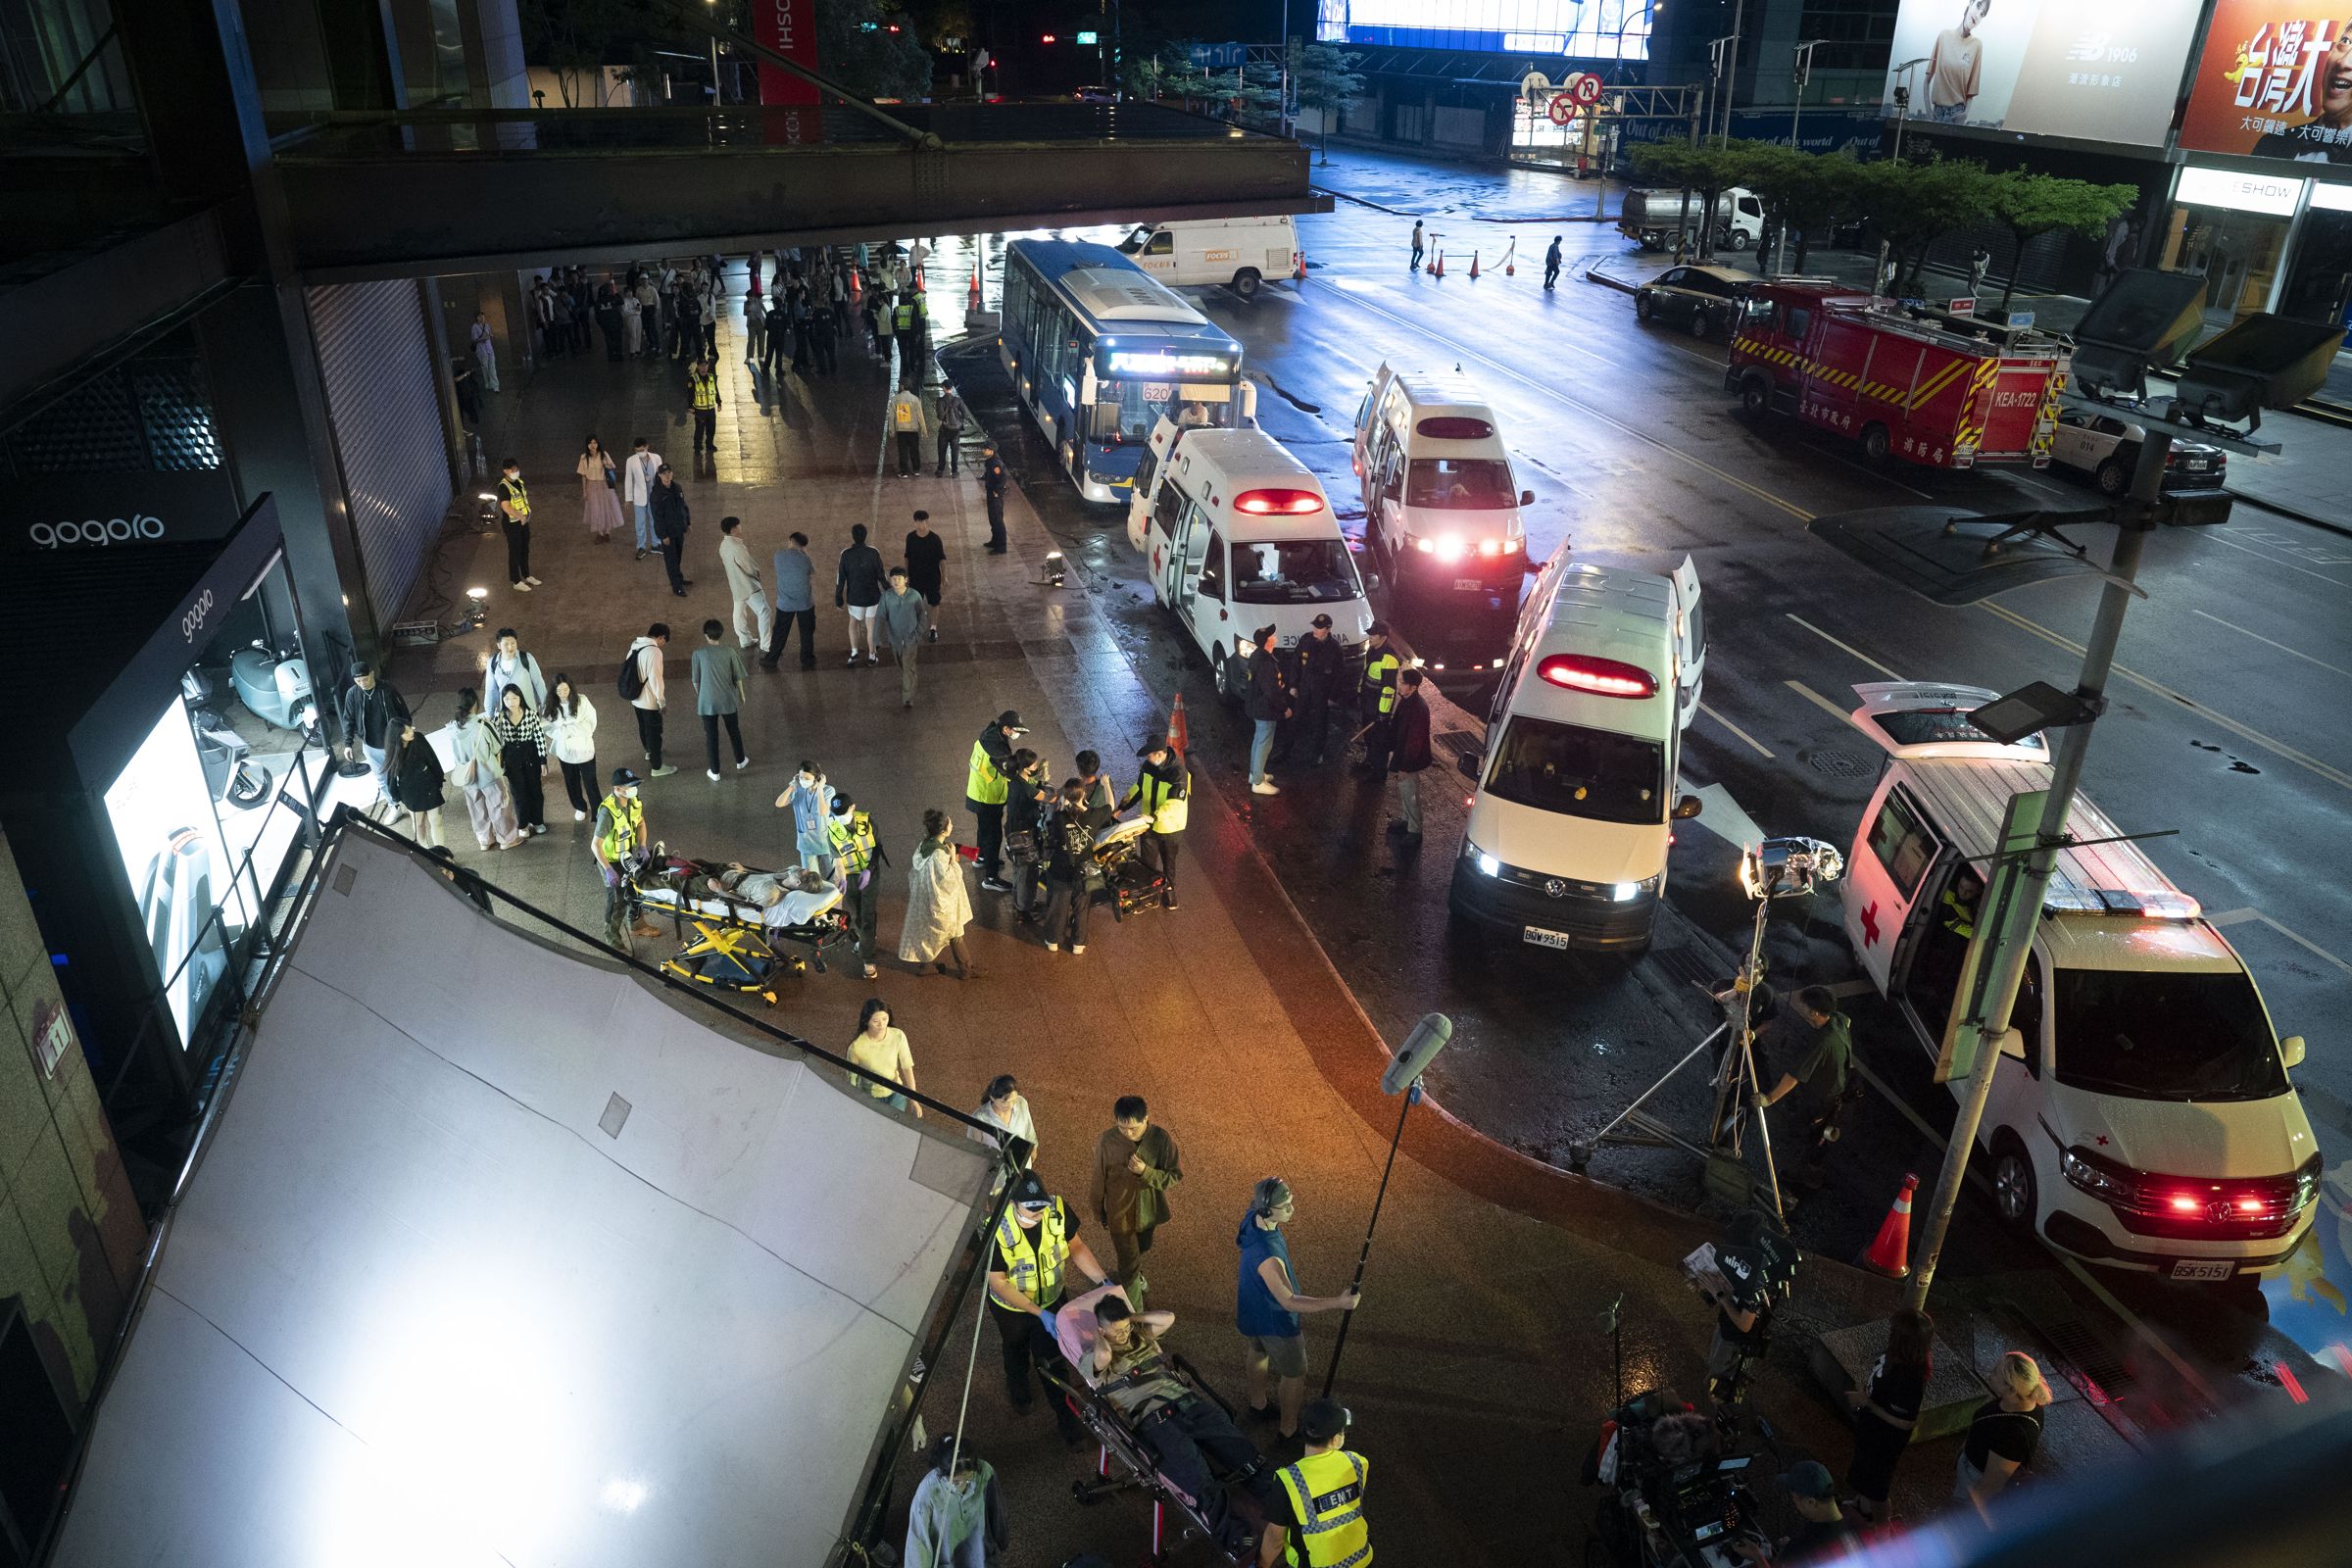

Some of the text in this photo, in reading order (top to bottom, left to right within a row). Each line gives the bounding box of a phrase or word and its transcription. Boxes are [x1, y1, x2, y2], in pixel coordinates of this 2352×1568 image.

[2107, 47, 2138, 64] 1906
[1802, 135, 1834, 147] world
[1206, 251, 1229, 260] FOCUS
[1144, 387, 1168, 400] 620
[1903, 436, 1943, 464] 消防局
[29, 514, 165, 549] gogoro
[182, 589, 214, 644] gogoro
[49, 1029, 64, 1057] 11
[1330, 1488, 1352, 1506] EMT
